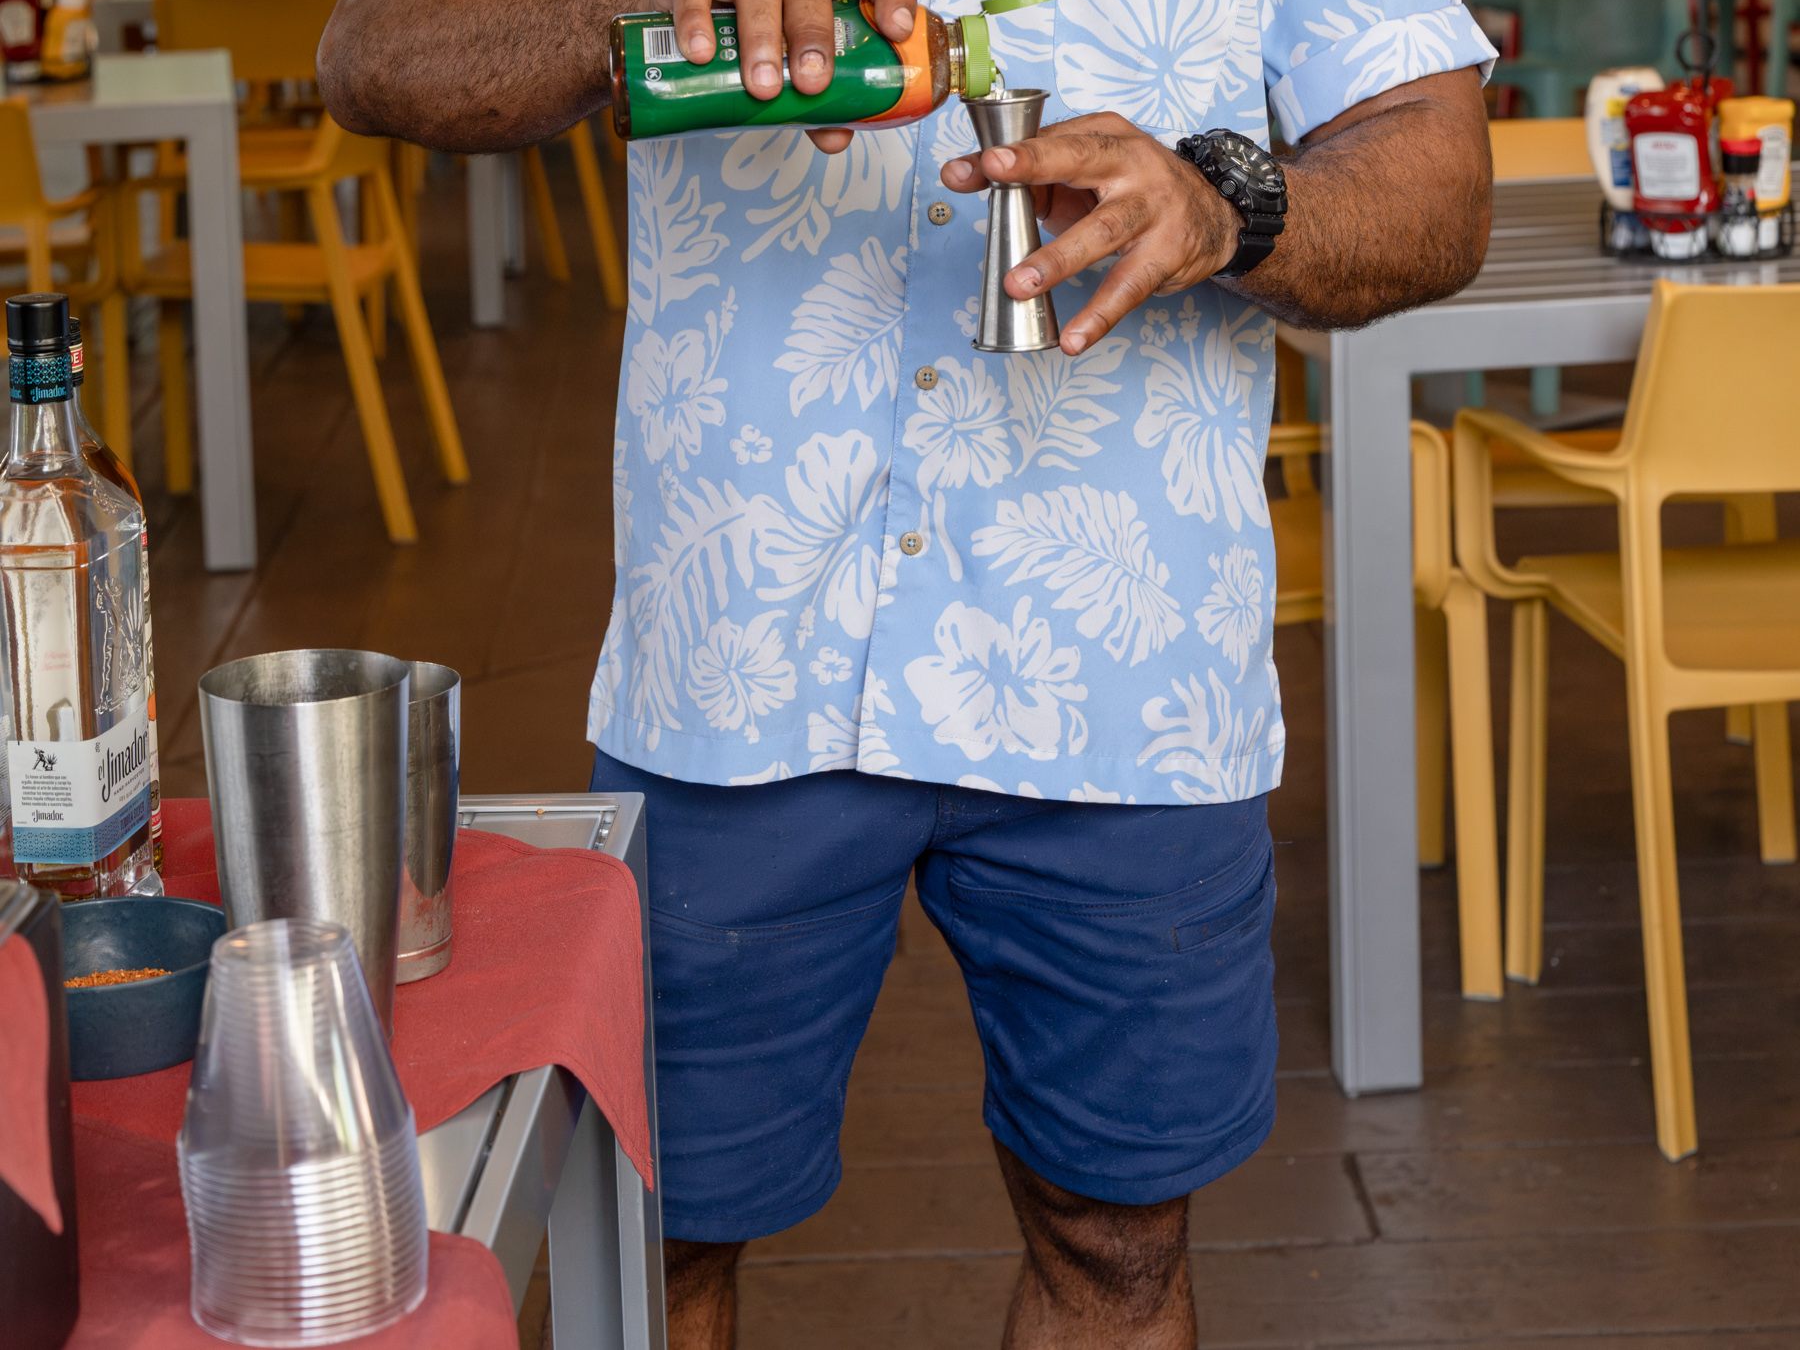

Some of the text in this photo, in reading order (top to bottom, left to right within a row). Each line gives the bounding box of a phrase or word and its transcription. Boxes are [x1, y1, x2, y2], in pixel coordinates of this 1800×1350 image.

[834, 16, 846, 57] ORGANIC
[98, 758, 105, 781] el
[102, 727, 148, 802] Jimador
[33, 809, 64, 823] Jimador
